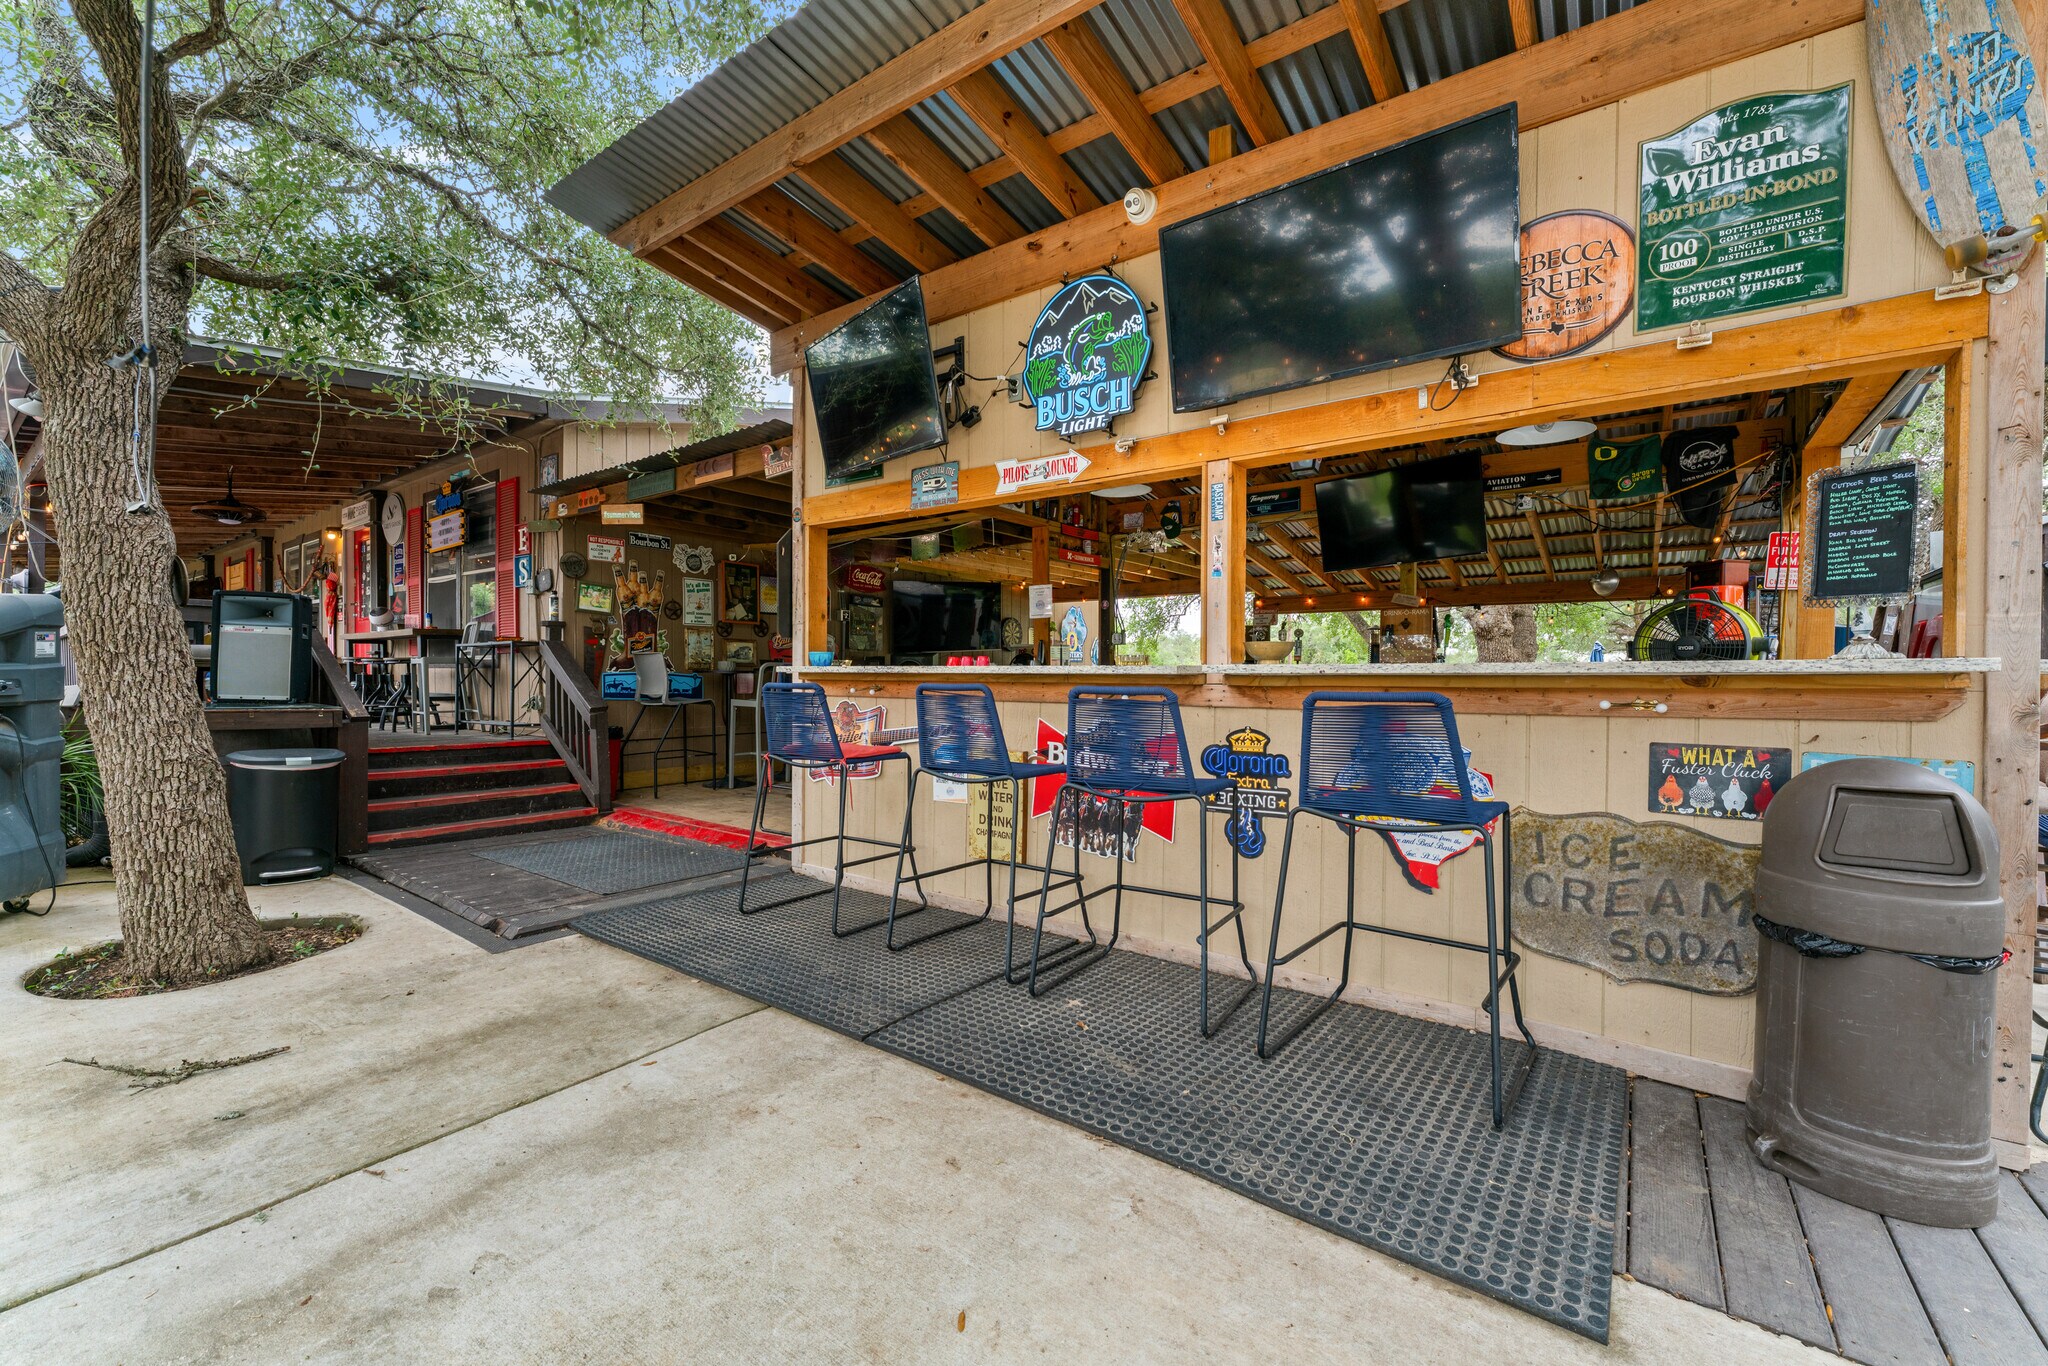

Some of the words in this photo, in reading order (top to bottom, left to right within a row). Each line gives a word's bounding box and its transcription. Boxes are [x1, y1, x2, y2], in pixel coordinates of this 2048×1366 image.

[1743, 103, 1774, 119] 1783
[1690, 125, 1788, 166] Evan
[1646, 166, 1838, 228] BOTTLED-IN-BOND
[1719, 217, 1764, 237] BOTTLED
[1765, 211, 1801, 226] UNDER
[1804, 207, 1824, 219] U.S.
[1719, 231, 1750, 244] GOV'T
[1752, 214, 1823, 237] SUPERVISION
[1659, 238, 1698, 262] 100
[1728, 239, 1765, 254] SINGLE
[1798, 225, 1826, 238] D.S.P.
[1801, 235, 1815, 245] KY
[1521, 238, 1620, 277] EBECCA
[1660, 256, 1698, 272] PROOF
[1718, 244, 1775, 263] DISTILLERY
[1672, 274, 1737, 296] KENTUCKY
[1739, 261, 1805, 282] STRAIGHT
[1672, 286, 1735, 308] BOURBON
[1739, 273, 1805, 294] WHISKEY
[1521, 312, 1551, 324] ENDED
[1555, 305, 1594, 319] WHISKEY
[1527, 305, 1543, 316] NE
[1555, 293, 1604, 309] TEXAS
[1036, 377, 1131, 430] BUSCH
[1698, 443, 1728, 462] Rock
[1045, 456, 1078, 478] LOUNGE
[1690, 460, 1716, 470] CAFE
[913, 469, 928, 484] MESS
[1487, 476, 1526, 485] AVIATION
[1831, 479, 1864, 490] OUTDOOR
[1870, 476, 1888, 484] BEER
[1214, 483, 1223, 520] BASECAMP
[518, 527, 528, 551] E
[598, 537, 624, 546] RESPONSIBLE
[630, 535, 660, 548] Bourbon
[660, 539, 671, 549] St.
[1849, 528, 1878, 536] SELECTION
[519, 559, 528, 584] S
[1384, 609, 1430, 617] DRINK-O-RAMA
[1204, 747, 1290, 776] Corona
[1681, 746, 1736, 767] WHAT
[1744, 749, 1757, 768] A
[1661, 758, 1716, 776] Fuster
[1721, 761, 1774, 780] Cluck
[978, 790, 1013, 804] WTER
[991, 805, 1003, 813] ND
[1401, 837, 1414, 845] and
[1535, 831, 1641, 872] ICE
[1523, 872, 1751, 927] CREAM
[1609, 929, 1744, 976] SODA
